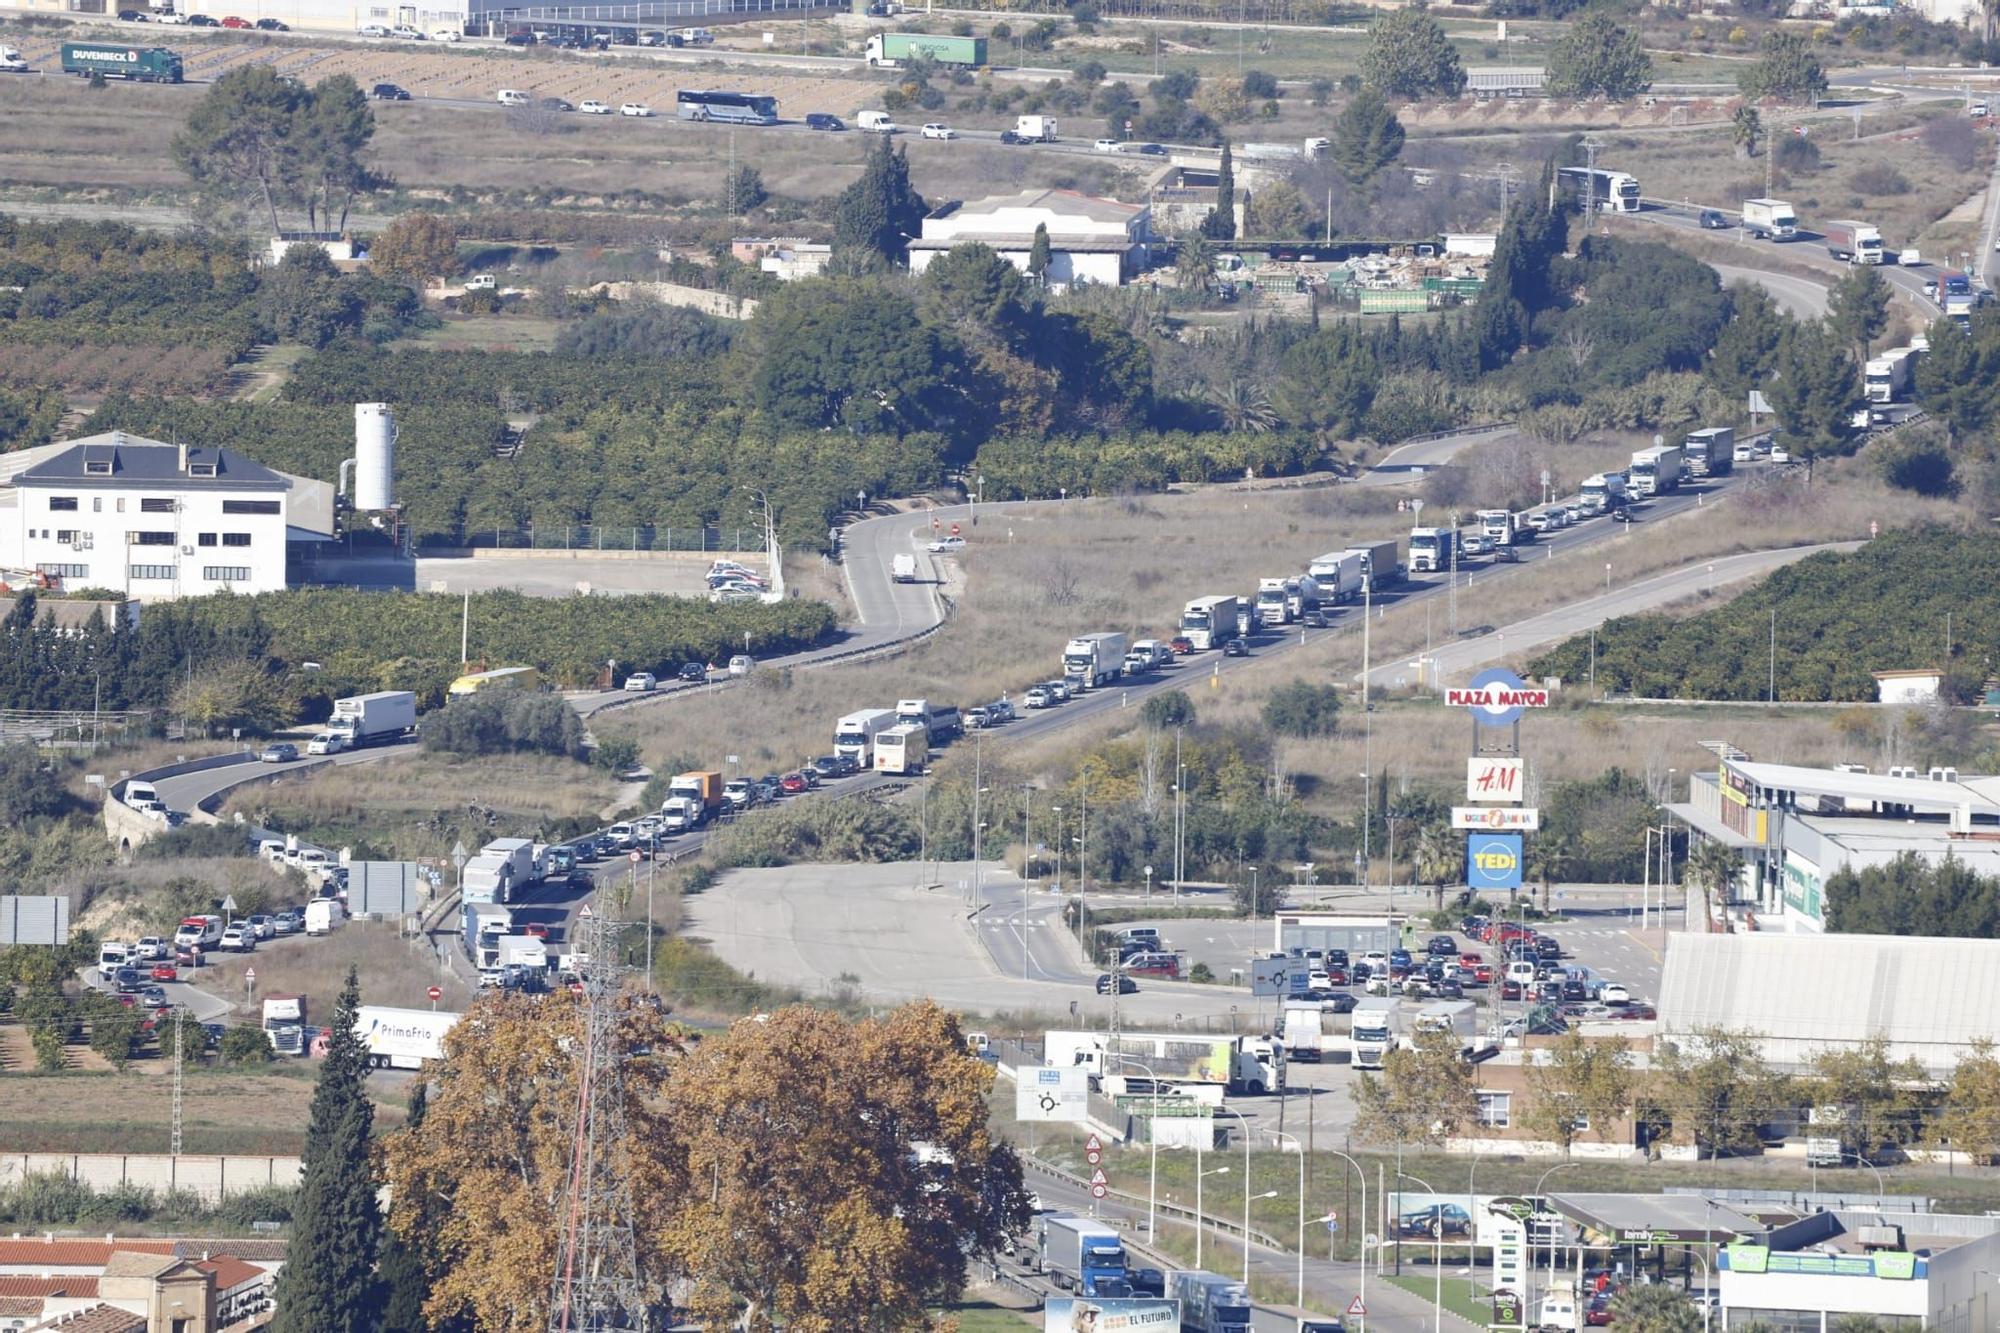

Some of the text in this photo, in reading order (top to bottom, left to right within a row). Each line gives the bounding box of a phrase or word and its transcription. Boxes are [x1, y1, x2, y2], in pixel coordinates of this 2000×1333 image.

[72, 50, 127, 61] DUVENBECK
[1449, 691, 1547, 706] PLAZA MAYOR
[1476, 766, 1517, 792] H&M
[1624, 1230, 1654, 1241] family
[1130, 1315, 1139, 1325] EL
[1141, 1311, 1171, 1324] FUTURO
